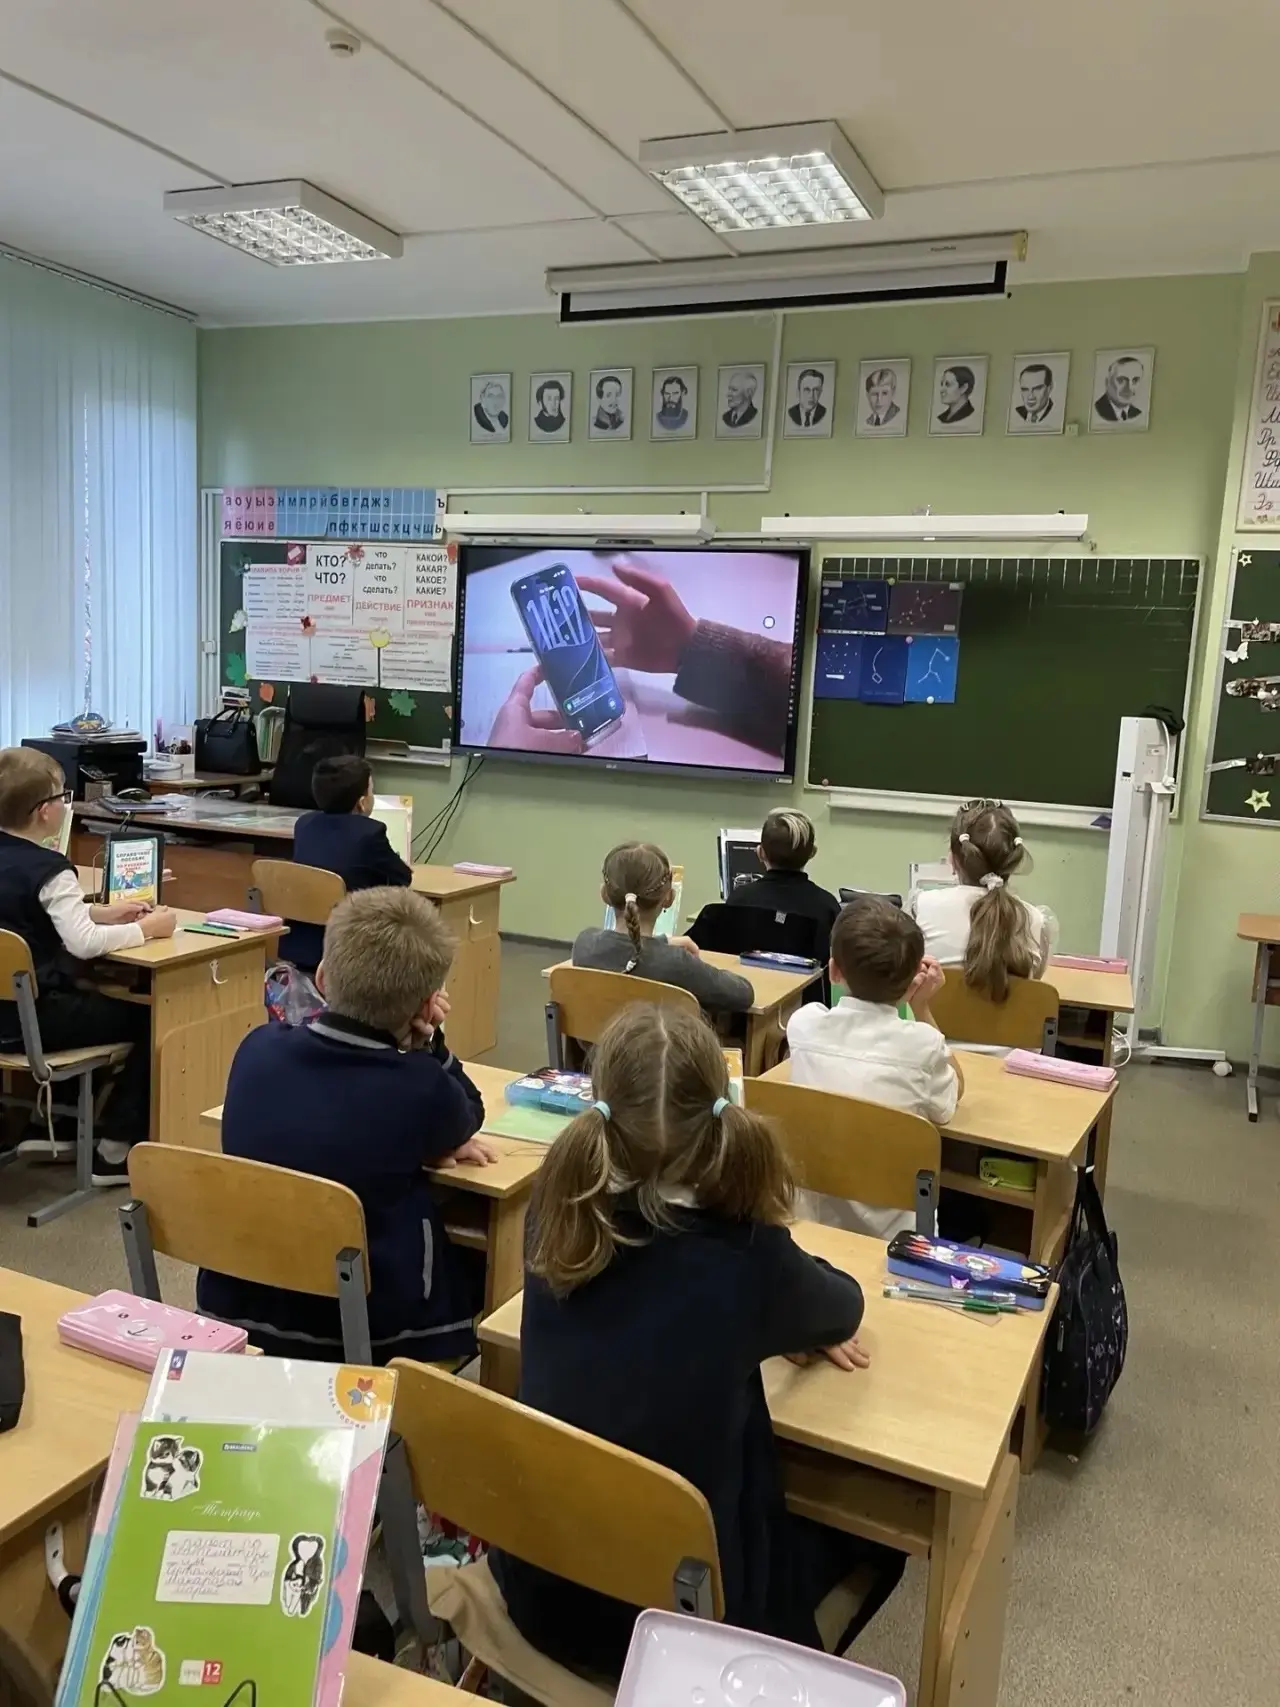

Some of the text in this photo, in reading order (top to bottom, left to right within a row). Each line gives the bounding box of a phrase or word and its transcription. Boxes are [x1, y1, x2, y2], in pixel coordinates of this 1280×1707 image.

[374, 551, 388, 559] что
[416, 553, 447, 562] КАКОЙ?
[315, 555, 347, 567] КТО?
[365, 562, 397, 571] делать?
[416, 564, 447, 573] КАКАЯ?
[314, 571, 346, 584] ЧТО?
[415, 576, 447, 584] КАКОЕ?
[362, 585, 398, 594] сделать?
[415, 586, 446, 595] КАКИЕ?
[307, 594, 351, 603] ПРЕДМЕТ
[355, 601, 402, 611] ДЕЙСТВИЕ
[407, 599, 454, 610] ПРИЗНАК
[205, 1663, 221, 1676] 12
